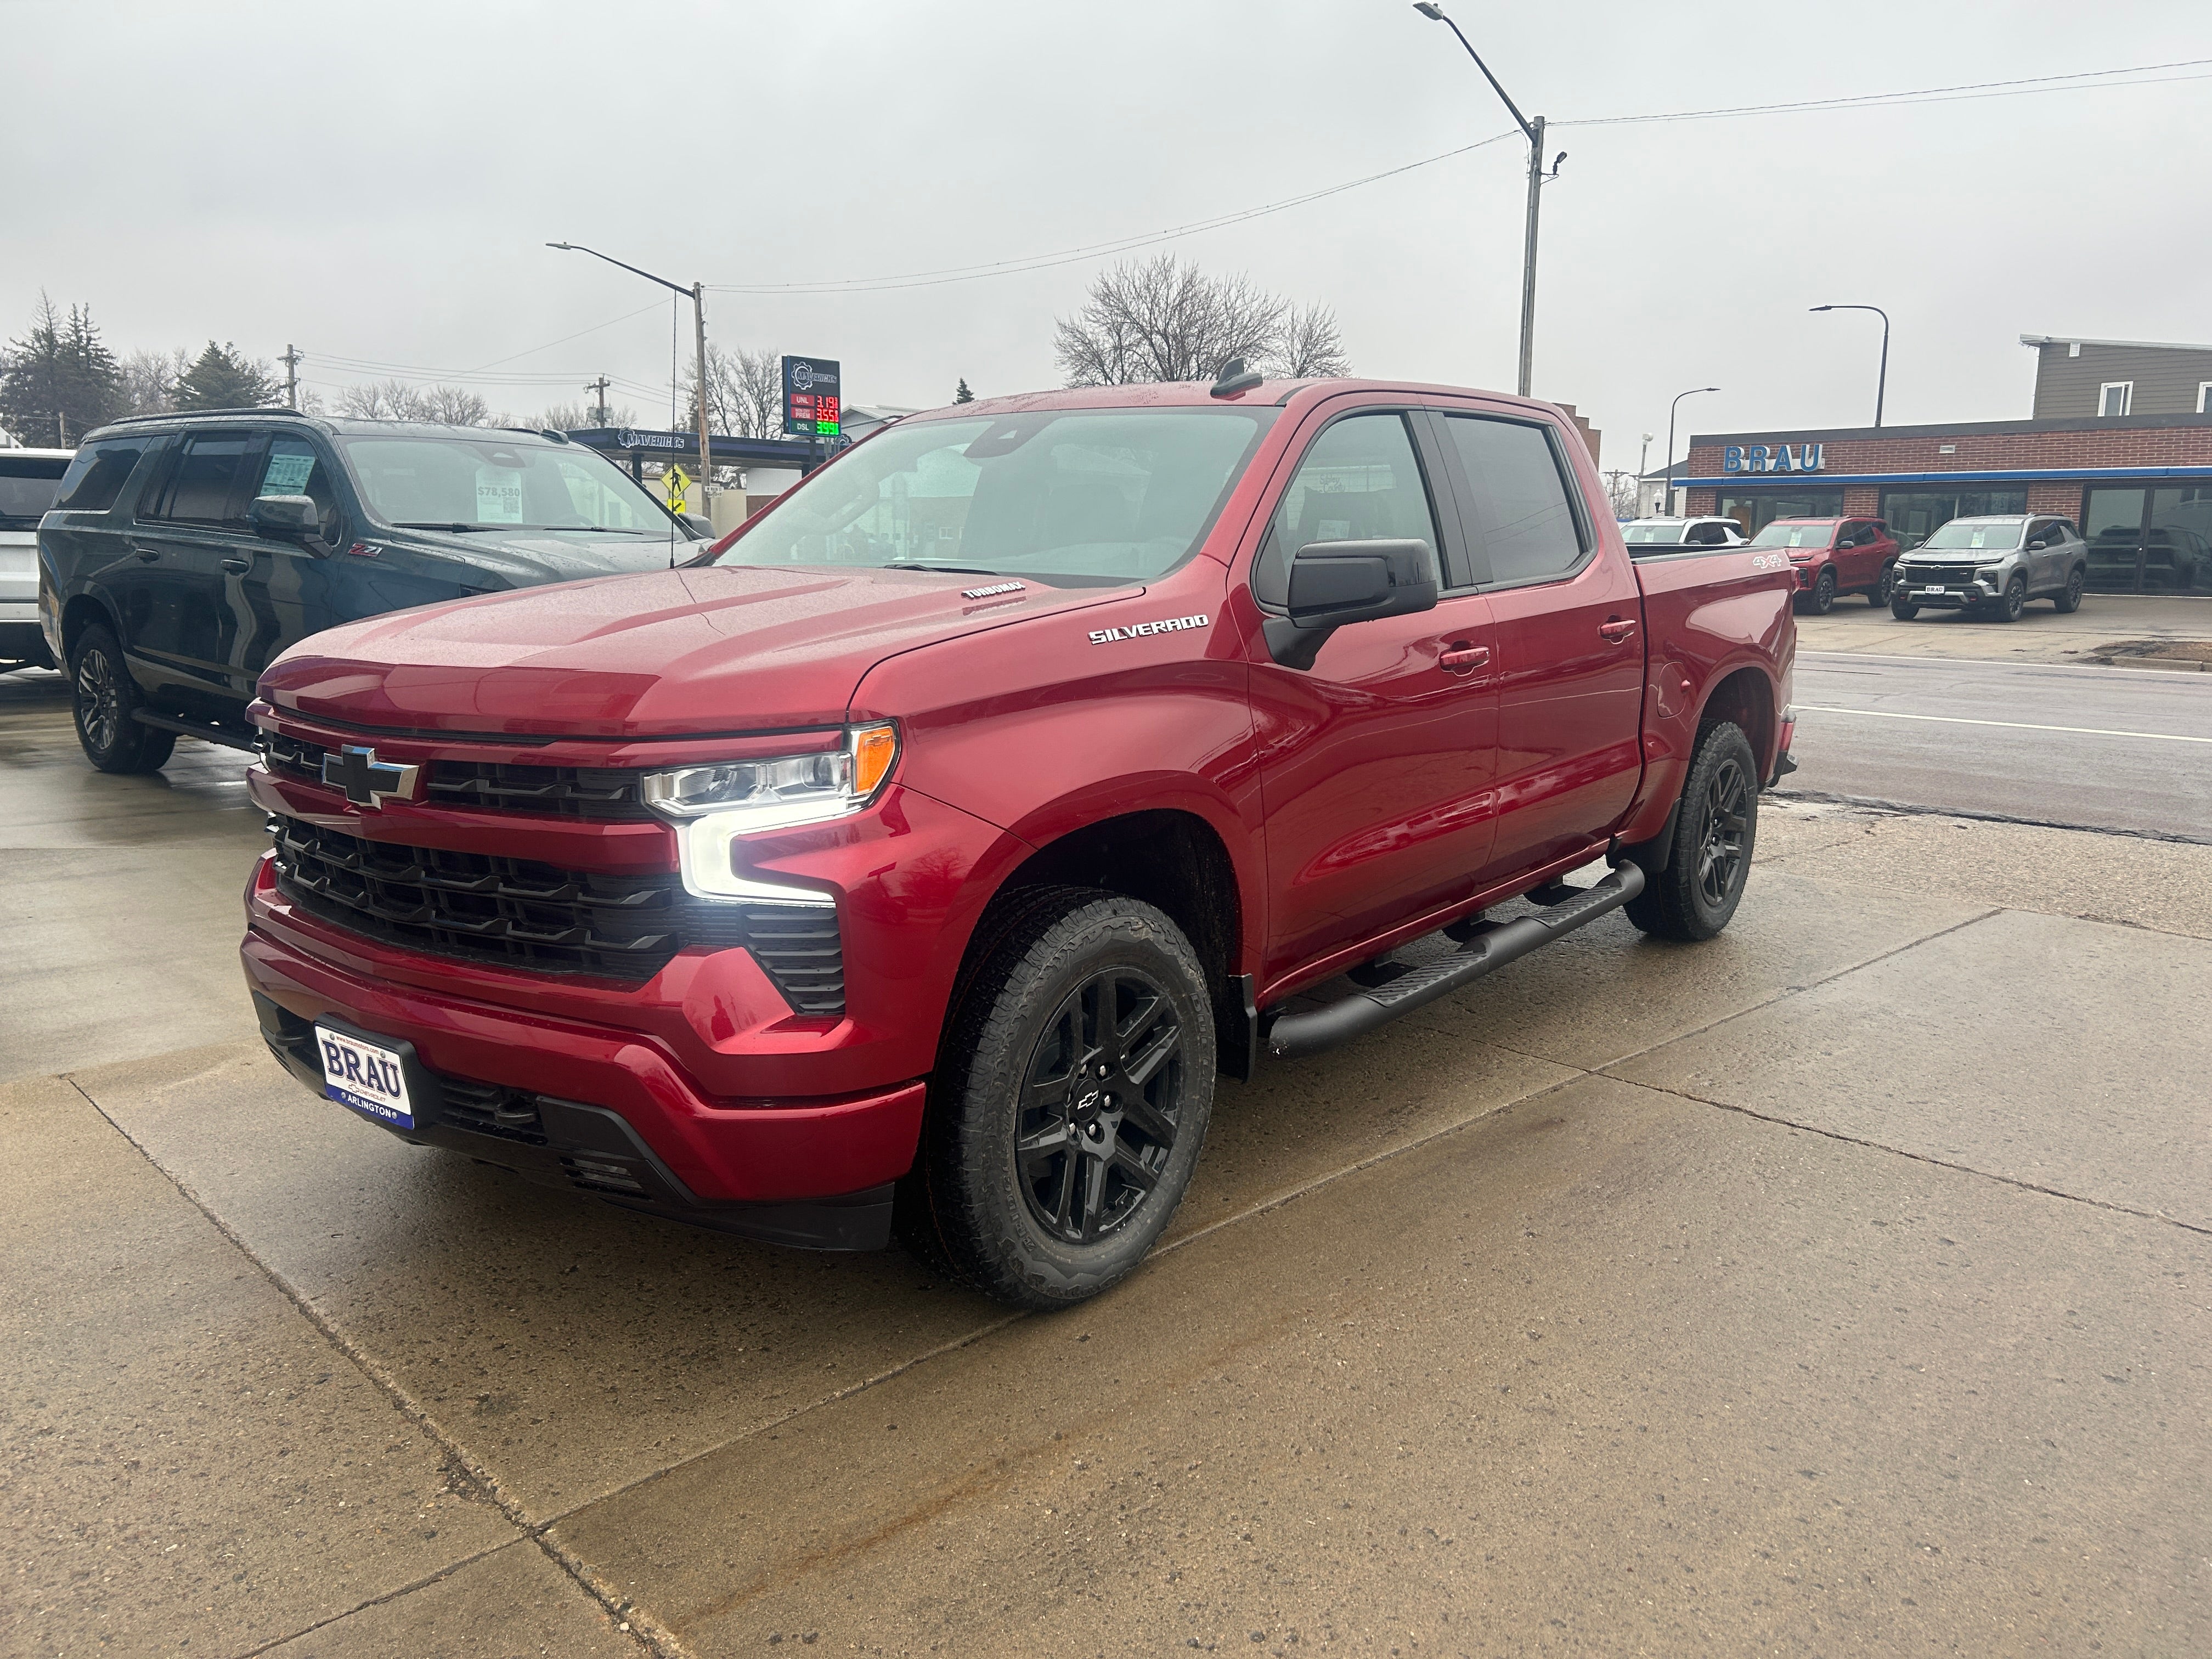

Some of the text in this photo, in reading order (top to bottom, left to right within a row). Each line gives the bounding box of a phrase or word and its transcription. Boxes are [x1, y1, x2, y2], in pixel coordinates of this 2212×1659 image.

[1723, 444, 1822, 472] BRAU
[478, 487, 520, 498] $78,580
[347, 543, 382, 557] Z71
[962, 582, 1026, 599] TURBOMAX
[1088, 614, 1209, 645] SILVERADO
[321, 1038, 402, 1099] BRAU
[360, 1089, 386, 1102] CHEVROLET
[348, 1094, 391, 1118] ARLINGTON
